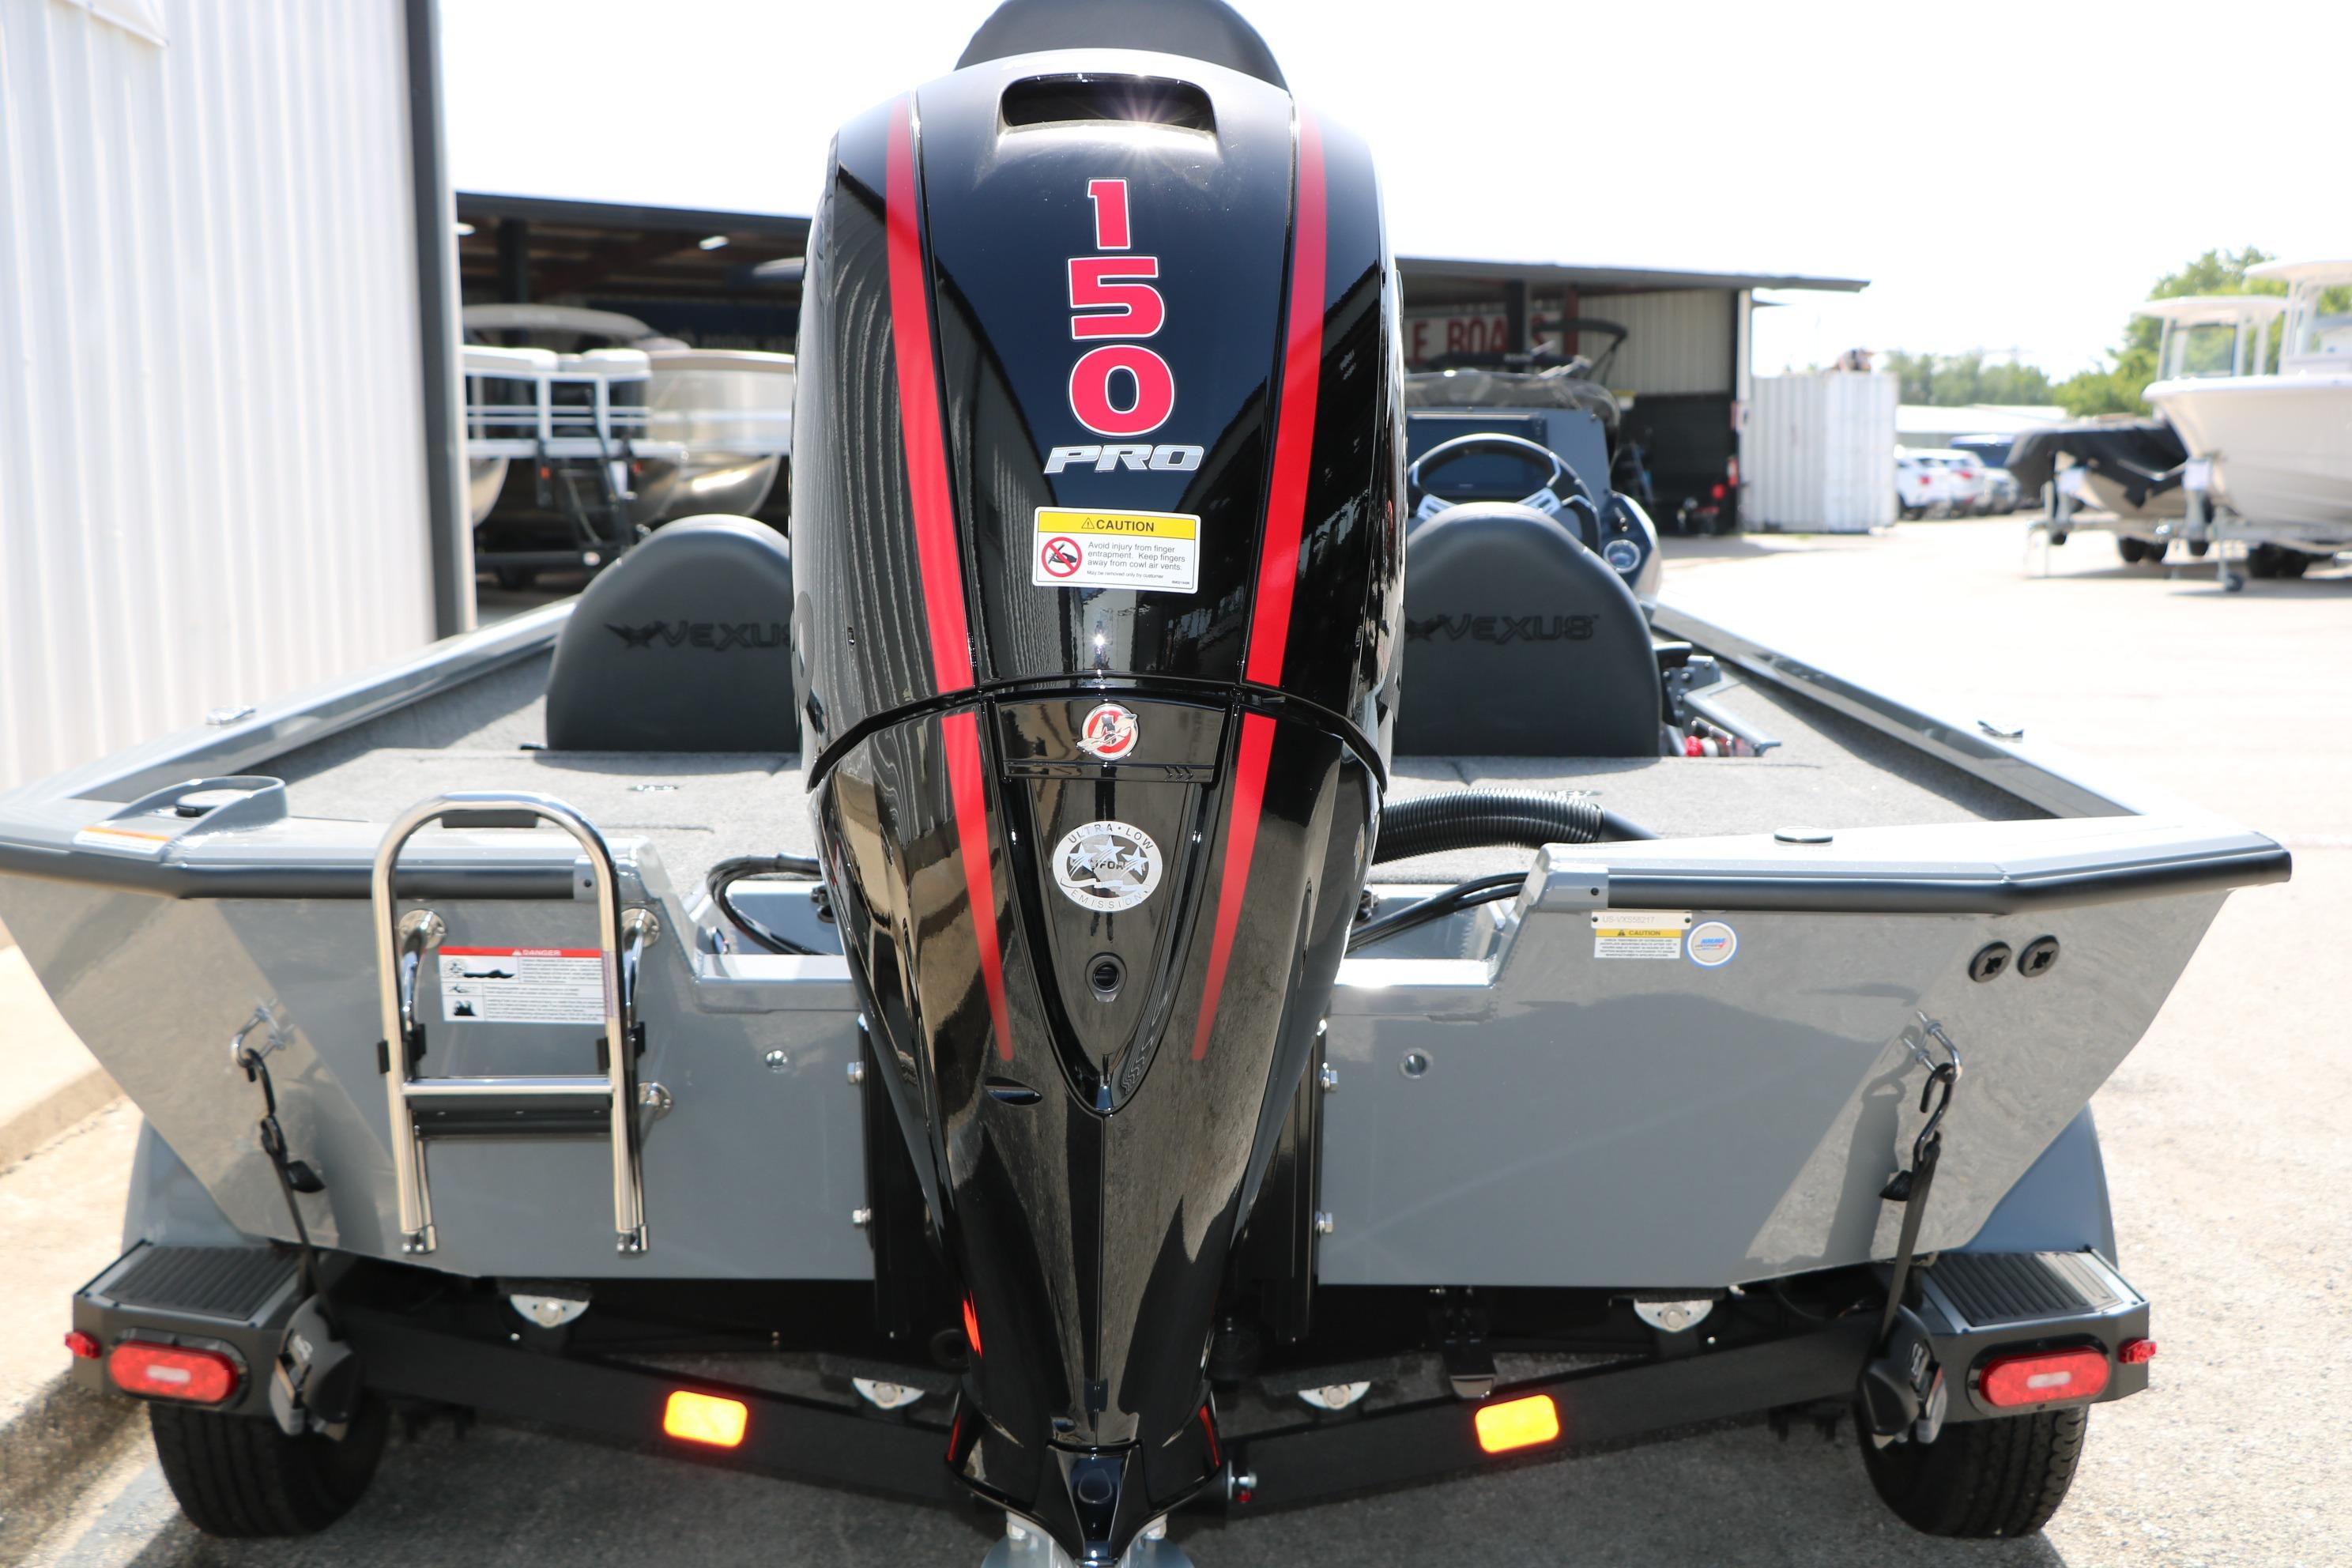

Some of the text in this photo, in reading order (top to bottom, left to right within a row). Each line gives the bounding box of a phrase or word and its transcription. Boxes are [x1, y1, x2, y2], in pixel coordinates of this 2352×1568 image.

[1068, 178, 1175, 437] 150
[1043, 444, 1204, 473] PRO
[1096, 518, 1155, 532] CAUTION
[1111, 542, 1133, 552] injury
[1154, 545, 1175, 554] finger
[1138, 552, 1159, 561] Keep
[1160, 554, 1185, 563] fingers
[656, 620, 790, 652] VEXU
[1438, 613, 1593, 645] VEXUS
[1068, 823, 1154, 850] ULTRA LOW
[1070, 889, 1142, 909] EMISSION
